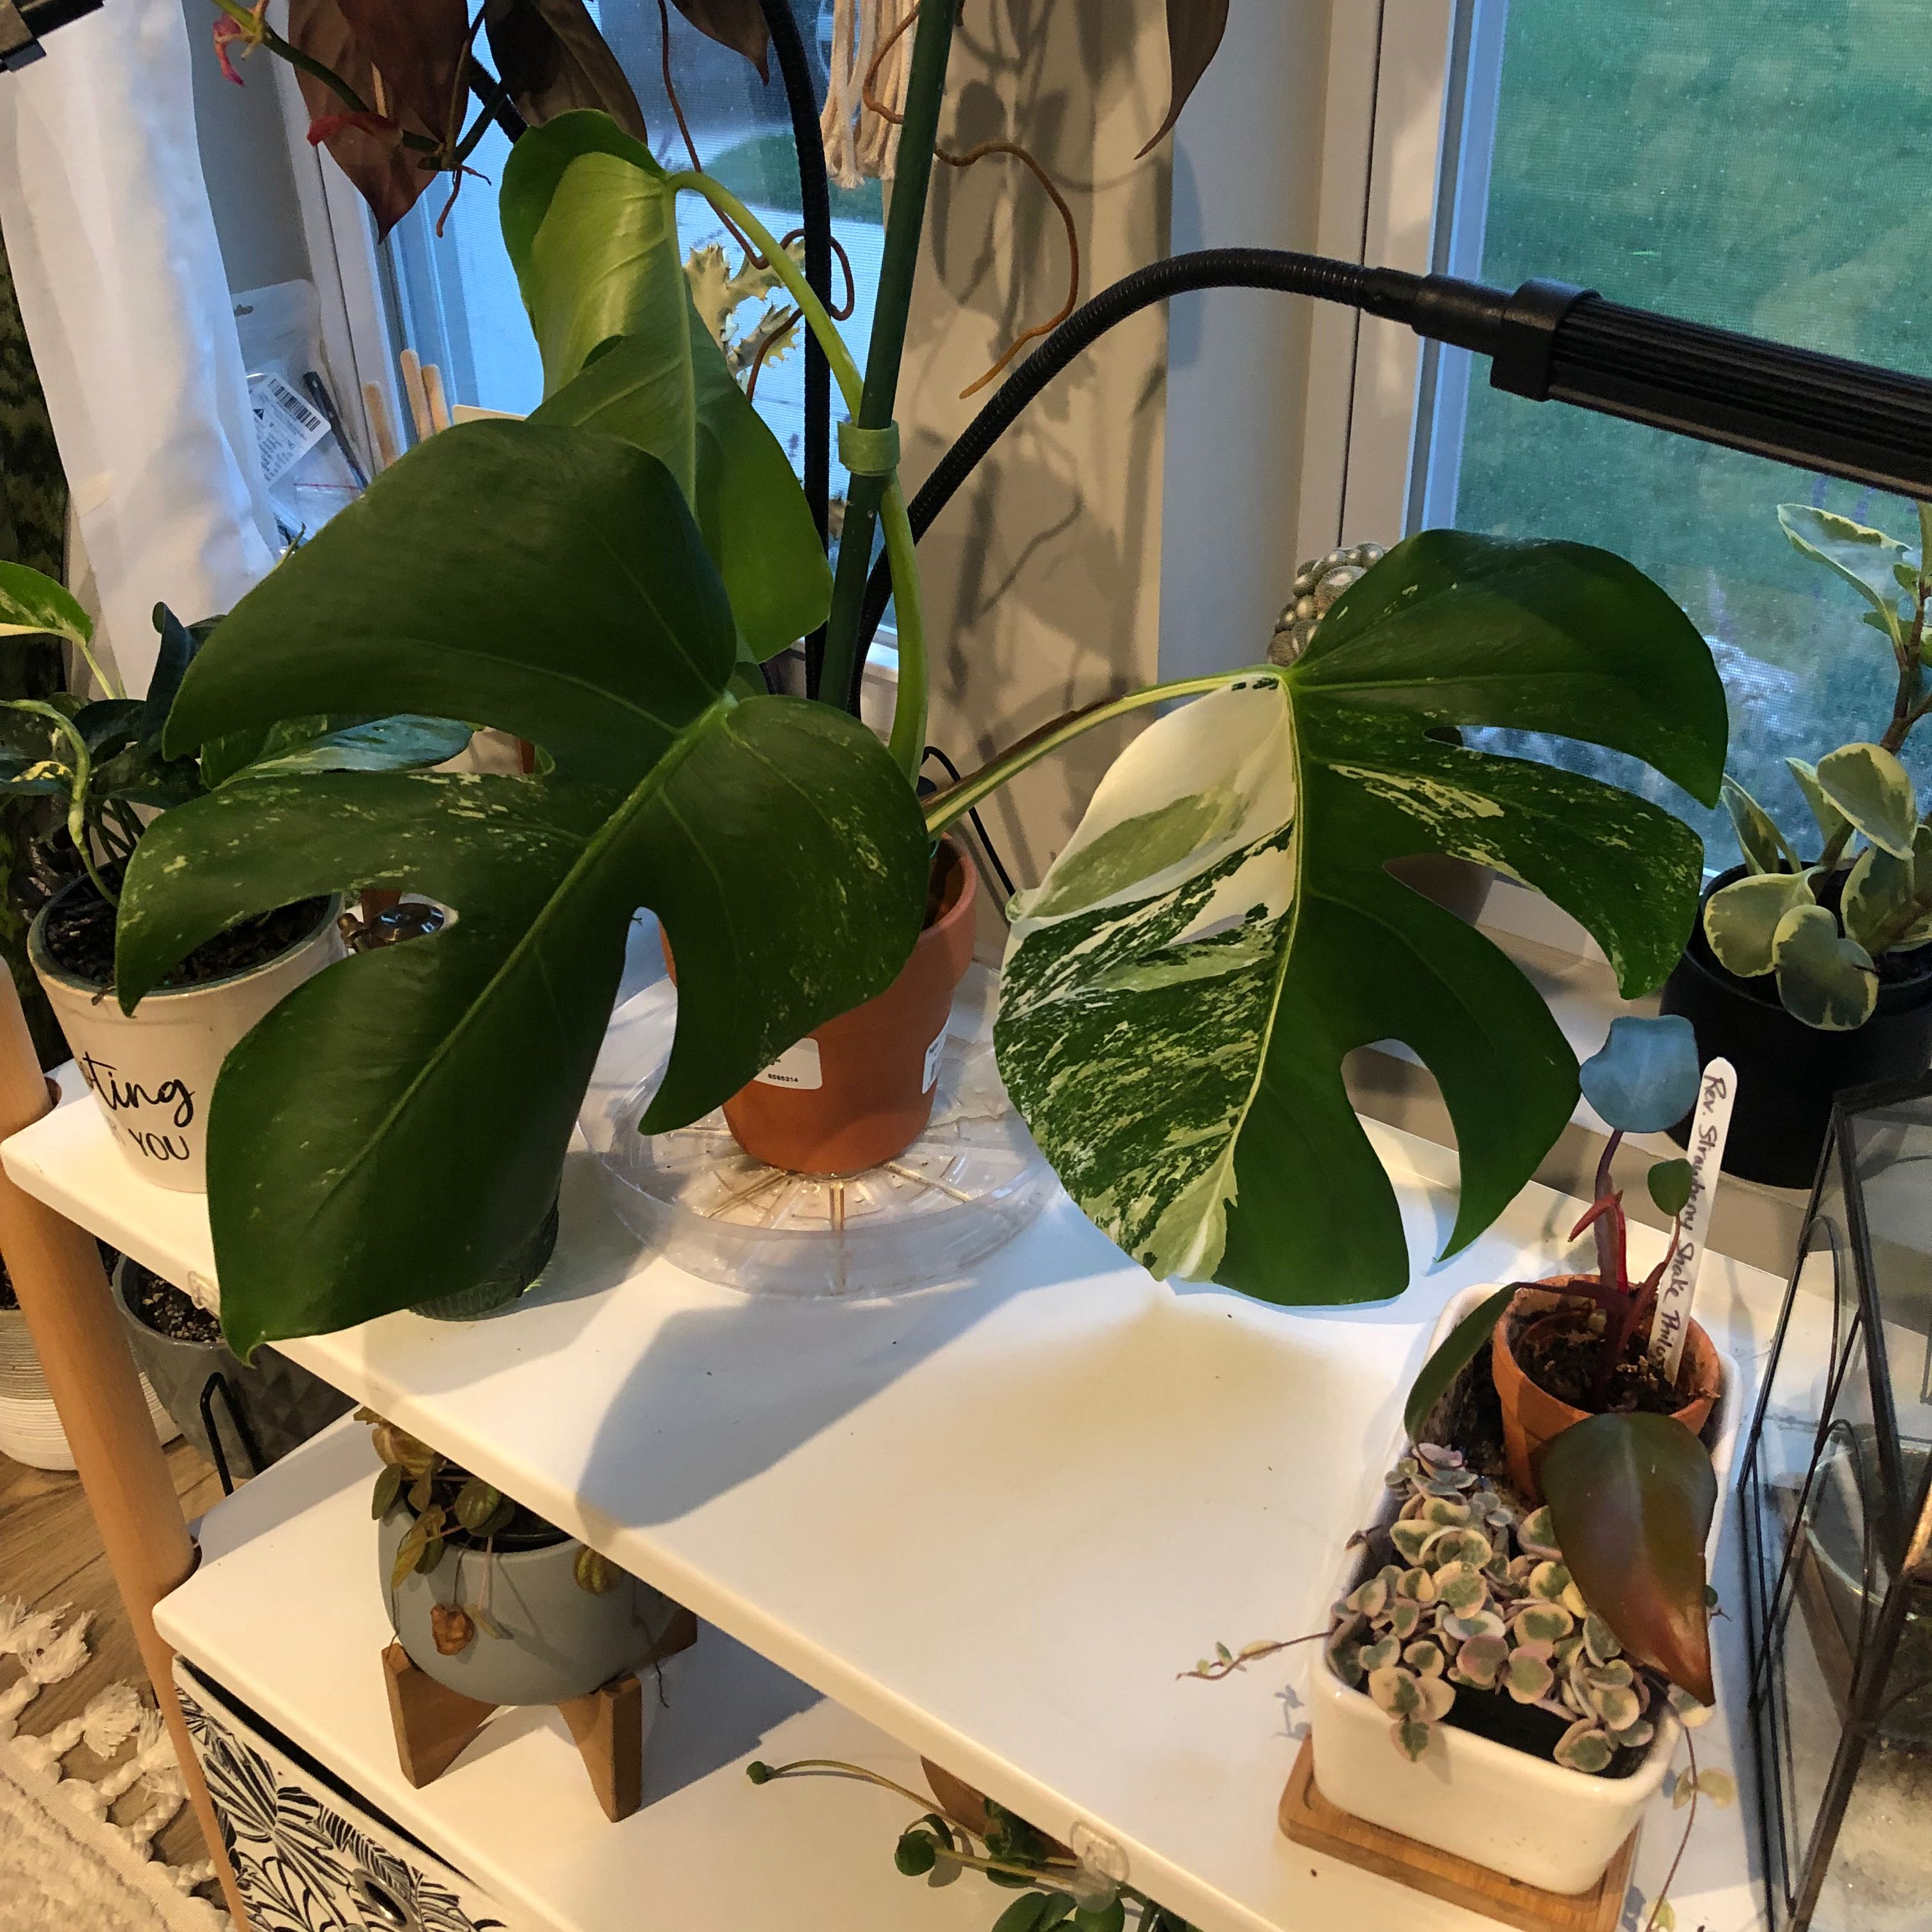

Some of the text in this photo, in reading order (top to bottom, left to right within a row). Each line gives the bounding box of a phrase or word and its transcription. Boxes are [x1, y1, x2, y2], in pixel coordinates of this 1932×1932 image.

[80, 1051, 195, 1128] ting
[128, 1128, 190, 1161] YOU
[1662, 1242, 1694, 1304] Shake
